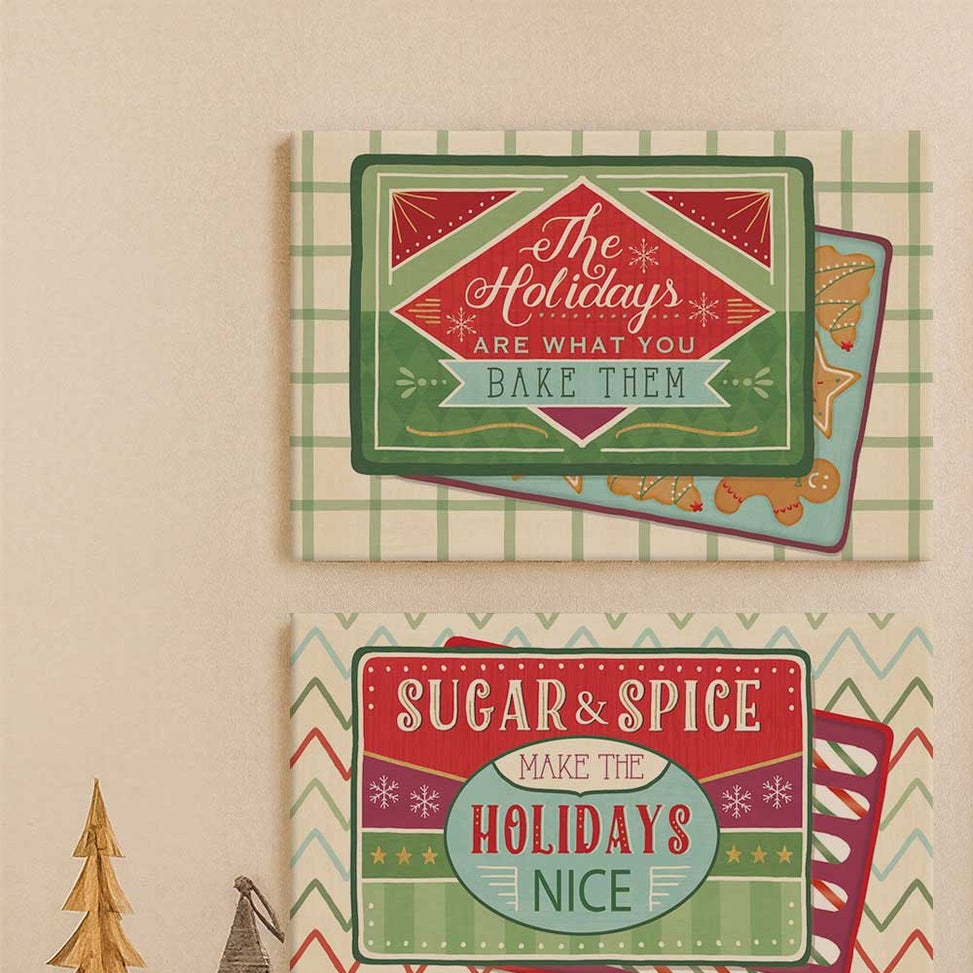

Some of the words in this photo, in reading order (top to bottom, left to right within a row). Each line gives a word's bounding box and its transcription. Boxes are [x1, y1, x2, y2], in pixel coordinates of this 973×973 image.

[519, 202, 623, 280] The
[465, 264, 682, 333] Holidays
[473, 337, 528, 354] ARE
[543, 337, 624, 354] WHAT
[637, 336, 695, 354] YOU
[487, 367, 576, 398] BAKE
[599, 367, 685, 398] THEM
[397, 678, 566, 733] SUGAR
[575, 691, 608, 726] &
[618, 679, 761, 733] SPICE
[519, 754, 589, 780] MAKE
[598, 754, 644, 779] THE
[471, 804, 691, 855] HOLIDAYS
[535, 869, 631, 912] NICE
